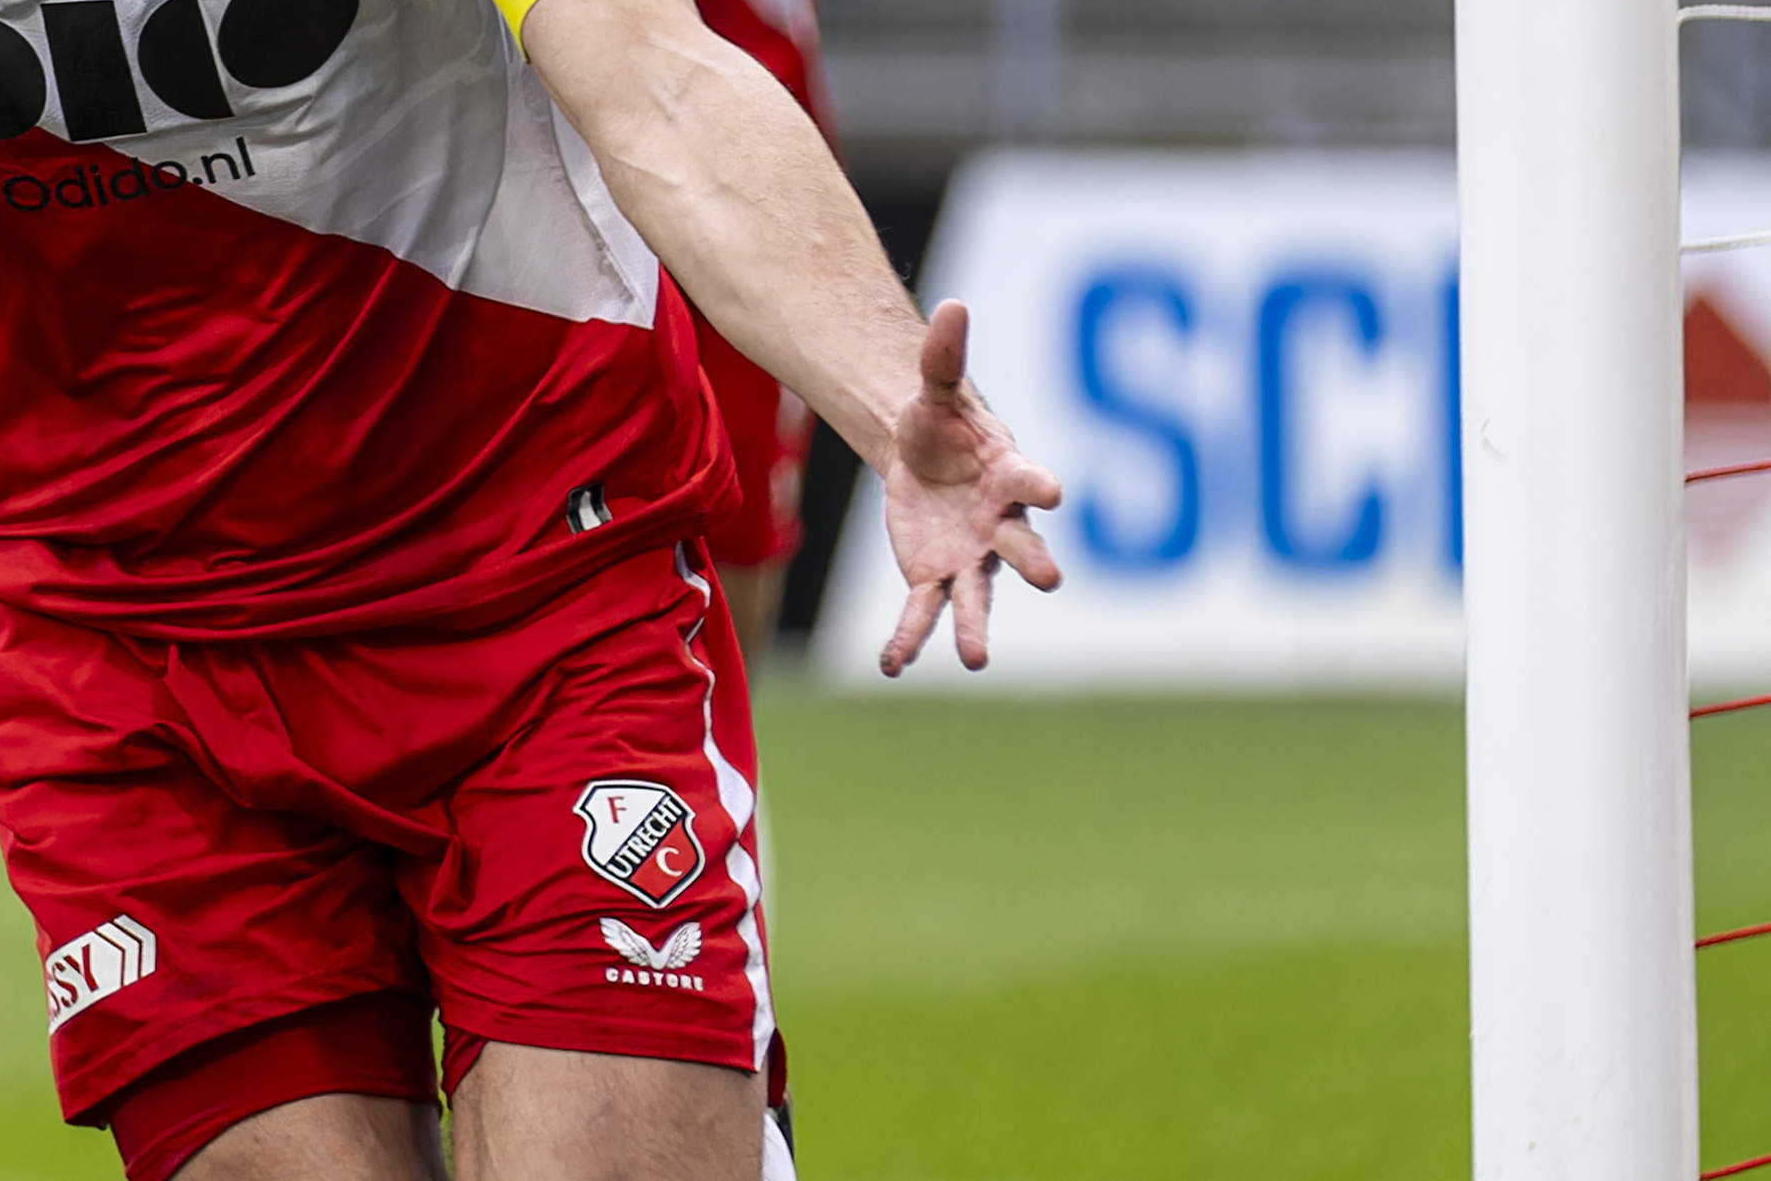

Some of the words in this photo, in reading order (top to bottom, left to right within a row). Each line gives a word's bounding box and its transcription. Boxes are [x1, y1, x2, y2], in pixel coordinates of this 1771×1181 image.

[607, 795, 627, 824] F
[605, 795, 683, 879] UTRECHT
[655, 847, 683, 877] C
[604, 967, 705, 992] CASTORE
